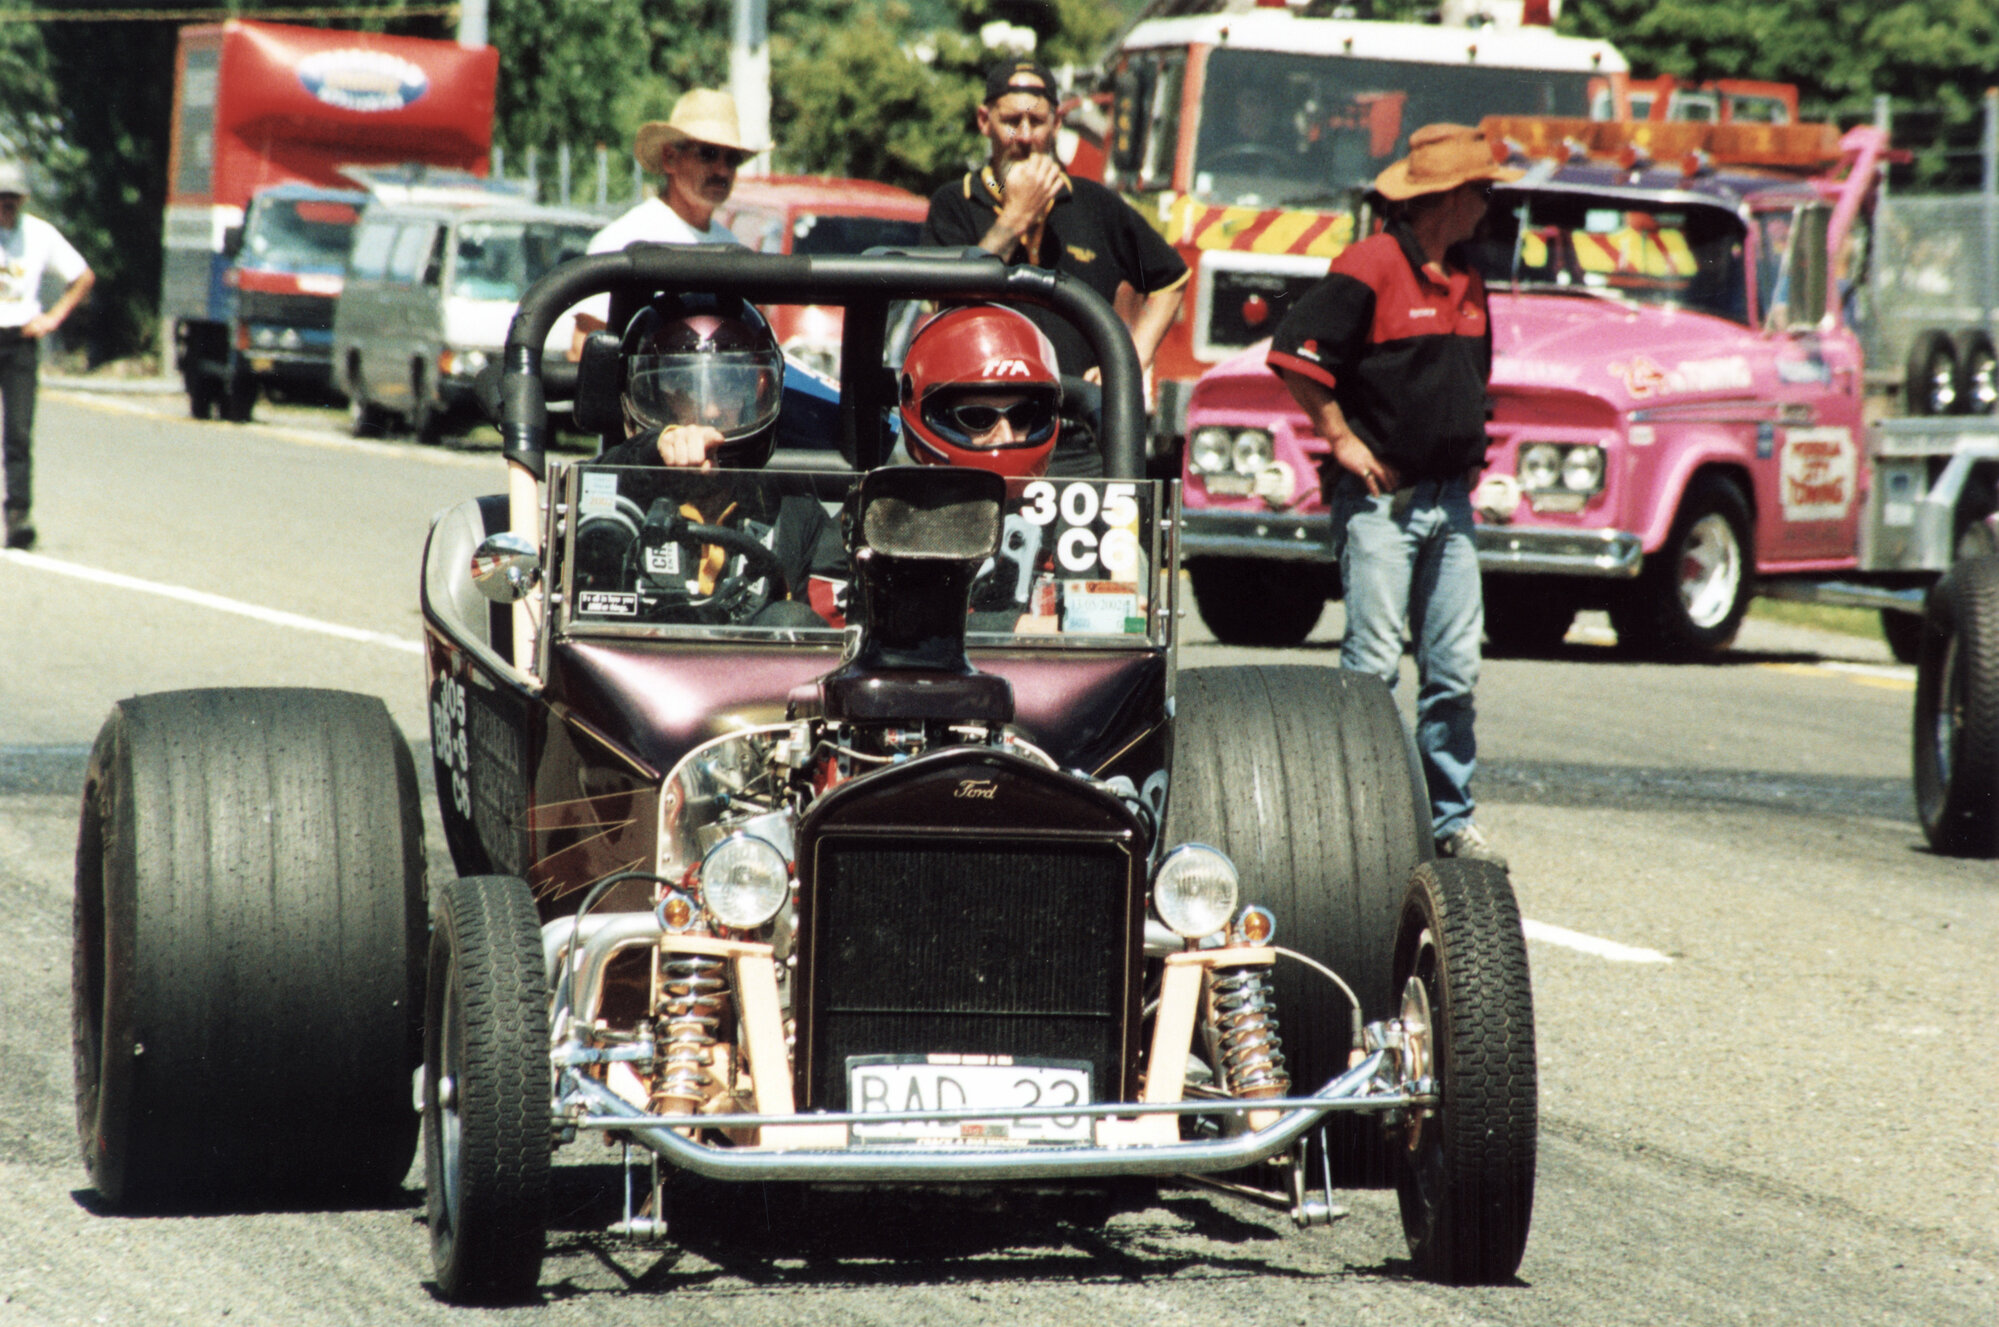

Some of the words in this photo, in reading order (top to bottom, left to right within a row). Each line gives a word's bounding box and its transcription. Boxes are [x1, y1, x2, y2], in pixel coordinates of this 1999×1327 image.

[1021, 480, 1139, 526] 305
[1057, 526, 1138, 573] C6
[440, 668, 466, 727] 305
[452, 769, 471, 820] C6
[953, 779, 998, 799] Ford
[861, 1075, 966, 1127] BAD
[1013, 1078, 1080, 1129] 23
